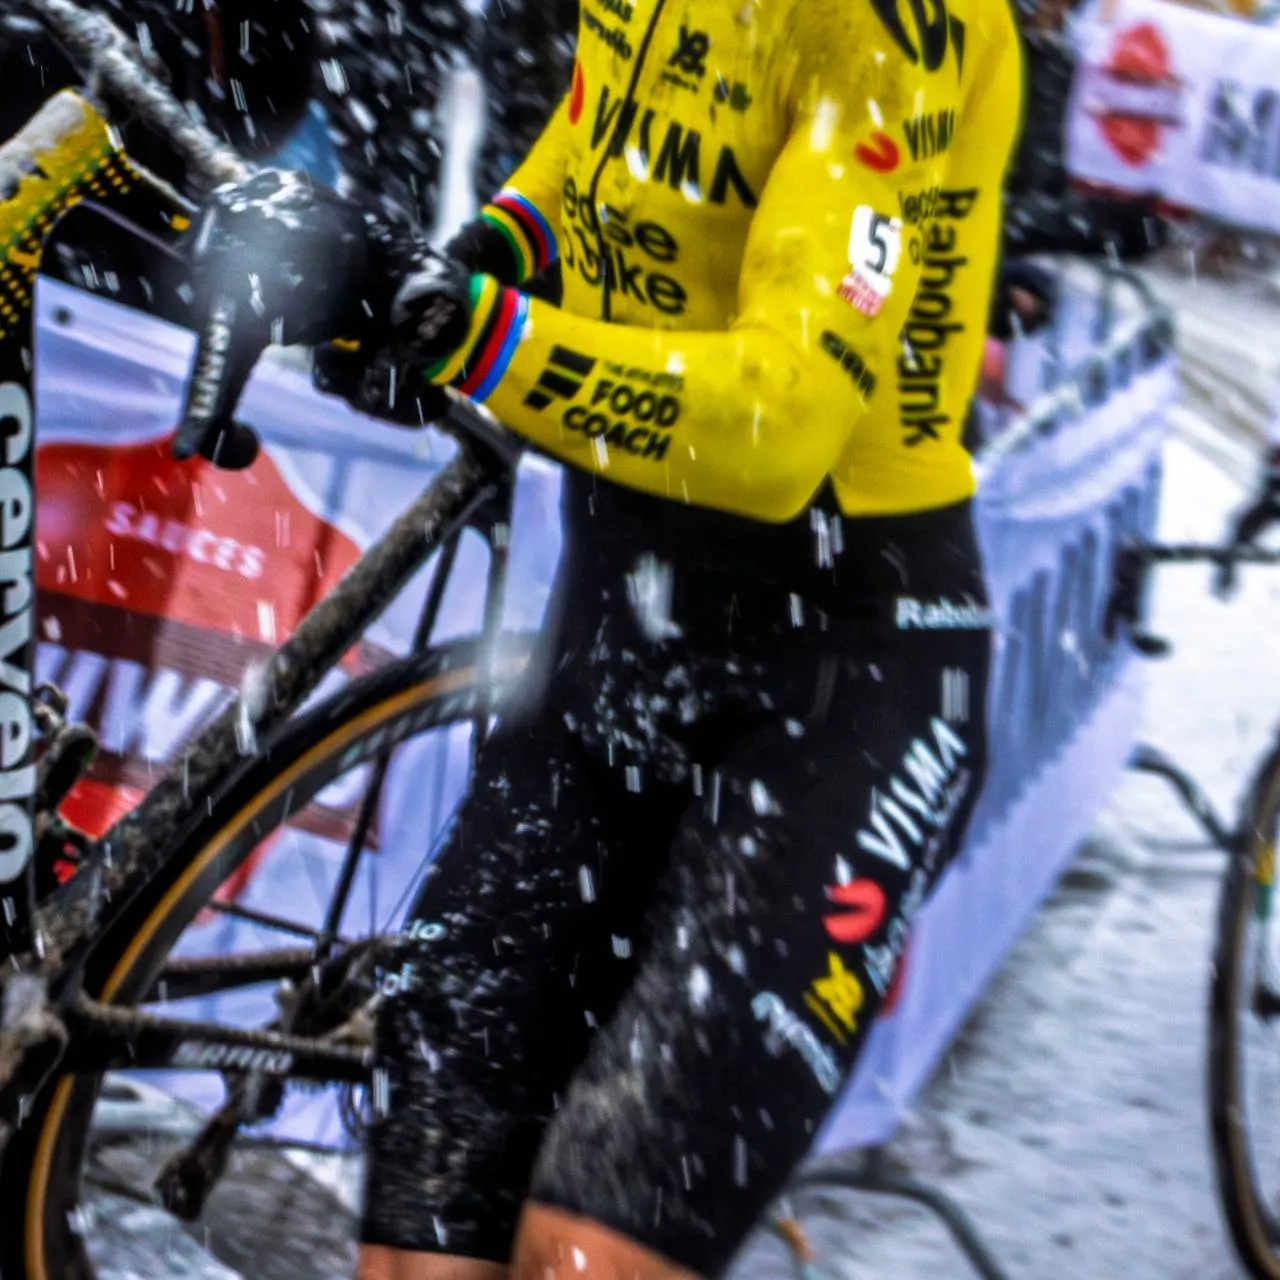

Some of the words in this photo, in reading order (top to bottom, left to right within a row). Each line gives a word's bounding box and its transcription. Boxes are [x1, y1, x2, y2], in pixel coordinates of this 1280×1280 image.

[864, 213, 892, 275] 5
[562, 406, 672, 462] COACH
[590, 379, 681, 428] FOOD
[104, 500, 268, 580] SAUCES
[856, 716, 967, 871] VISMA
